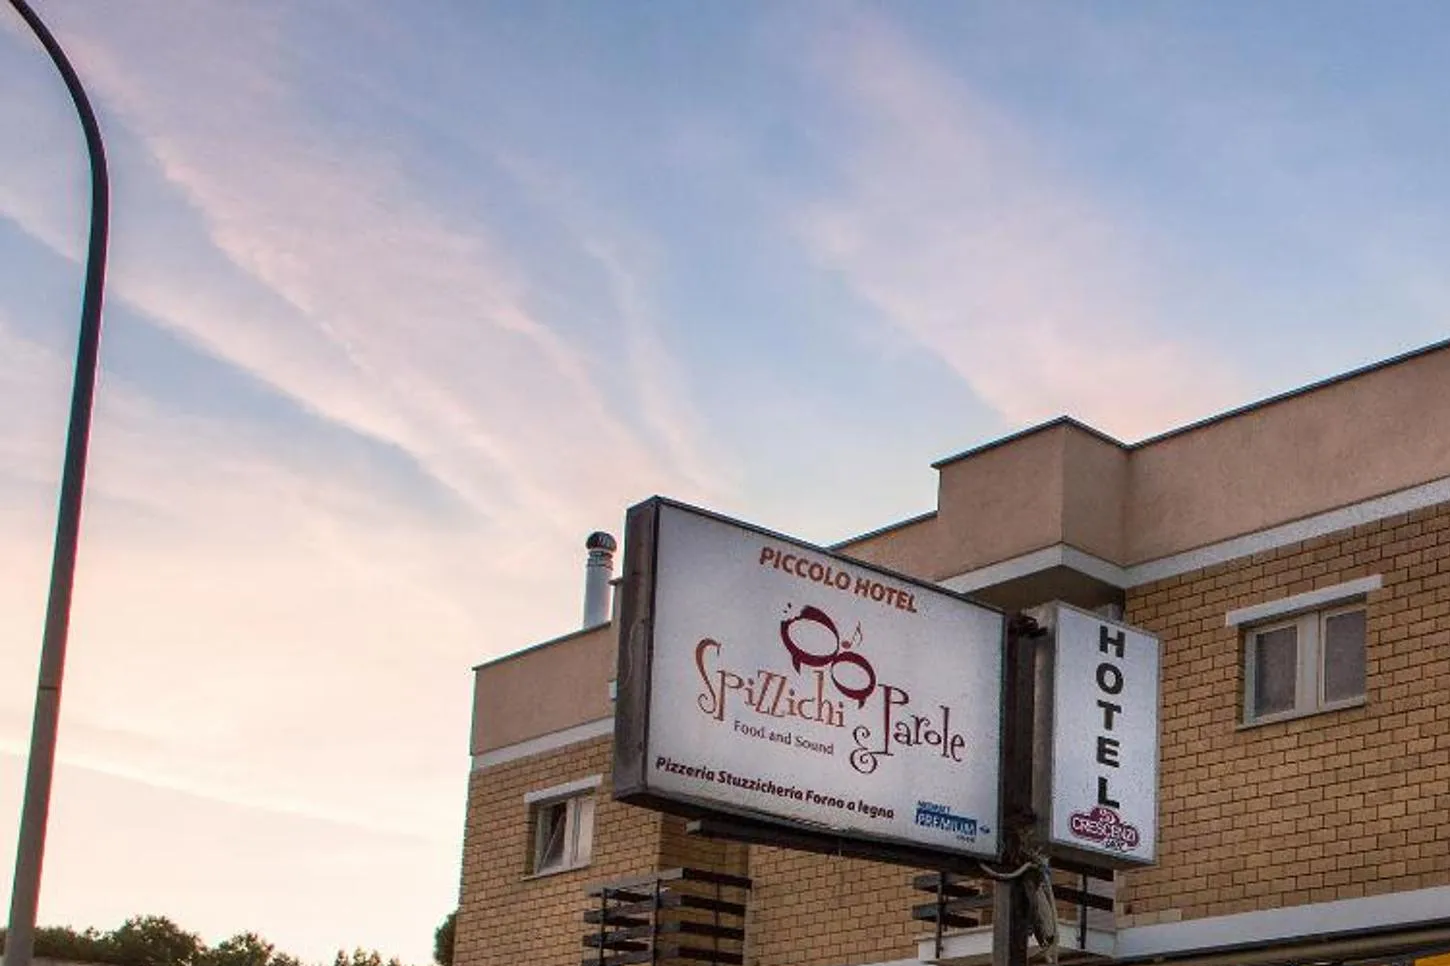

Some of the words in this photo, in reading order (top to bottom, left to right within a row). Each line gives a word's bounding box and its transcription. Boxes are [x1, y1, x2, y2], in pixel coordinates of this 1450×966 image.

[759, 546, 851, 590] PICCOLO
[854, 577, 917, 613] HOTEL
[733, 720, 766, 739] Food
[769, 730, 792, 746] and
[796, 735, 834, 756] Sound
[878, 683, 965, 762] Parole
[1096, 626, 1126, 809] HOTEL
[655, 757, 715, 782] Pizzeria
[717, 770, 803, 801] Stuzzicheria
[805, 790, 844, 809] Forno
[846, 801, 855, 811] a
[857, 800, 894, 820] legna
